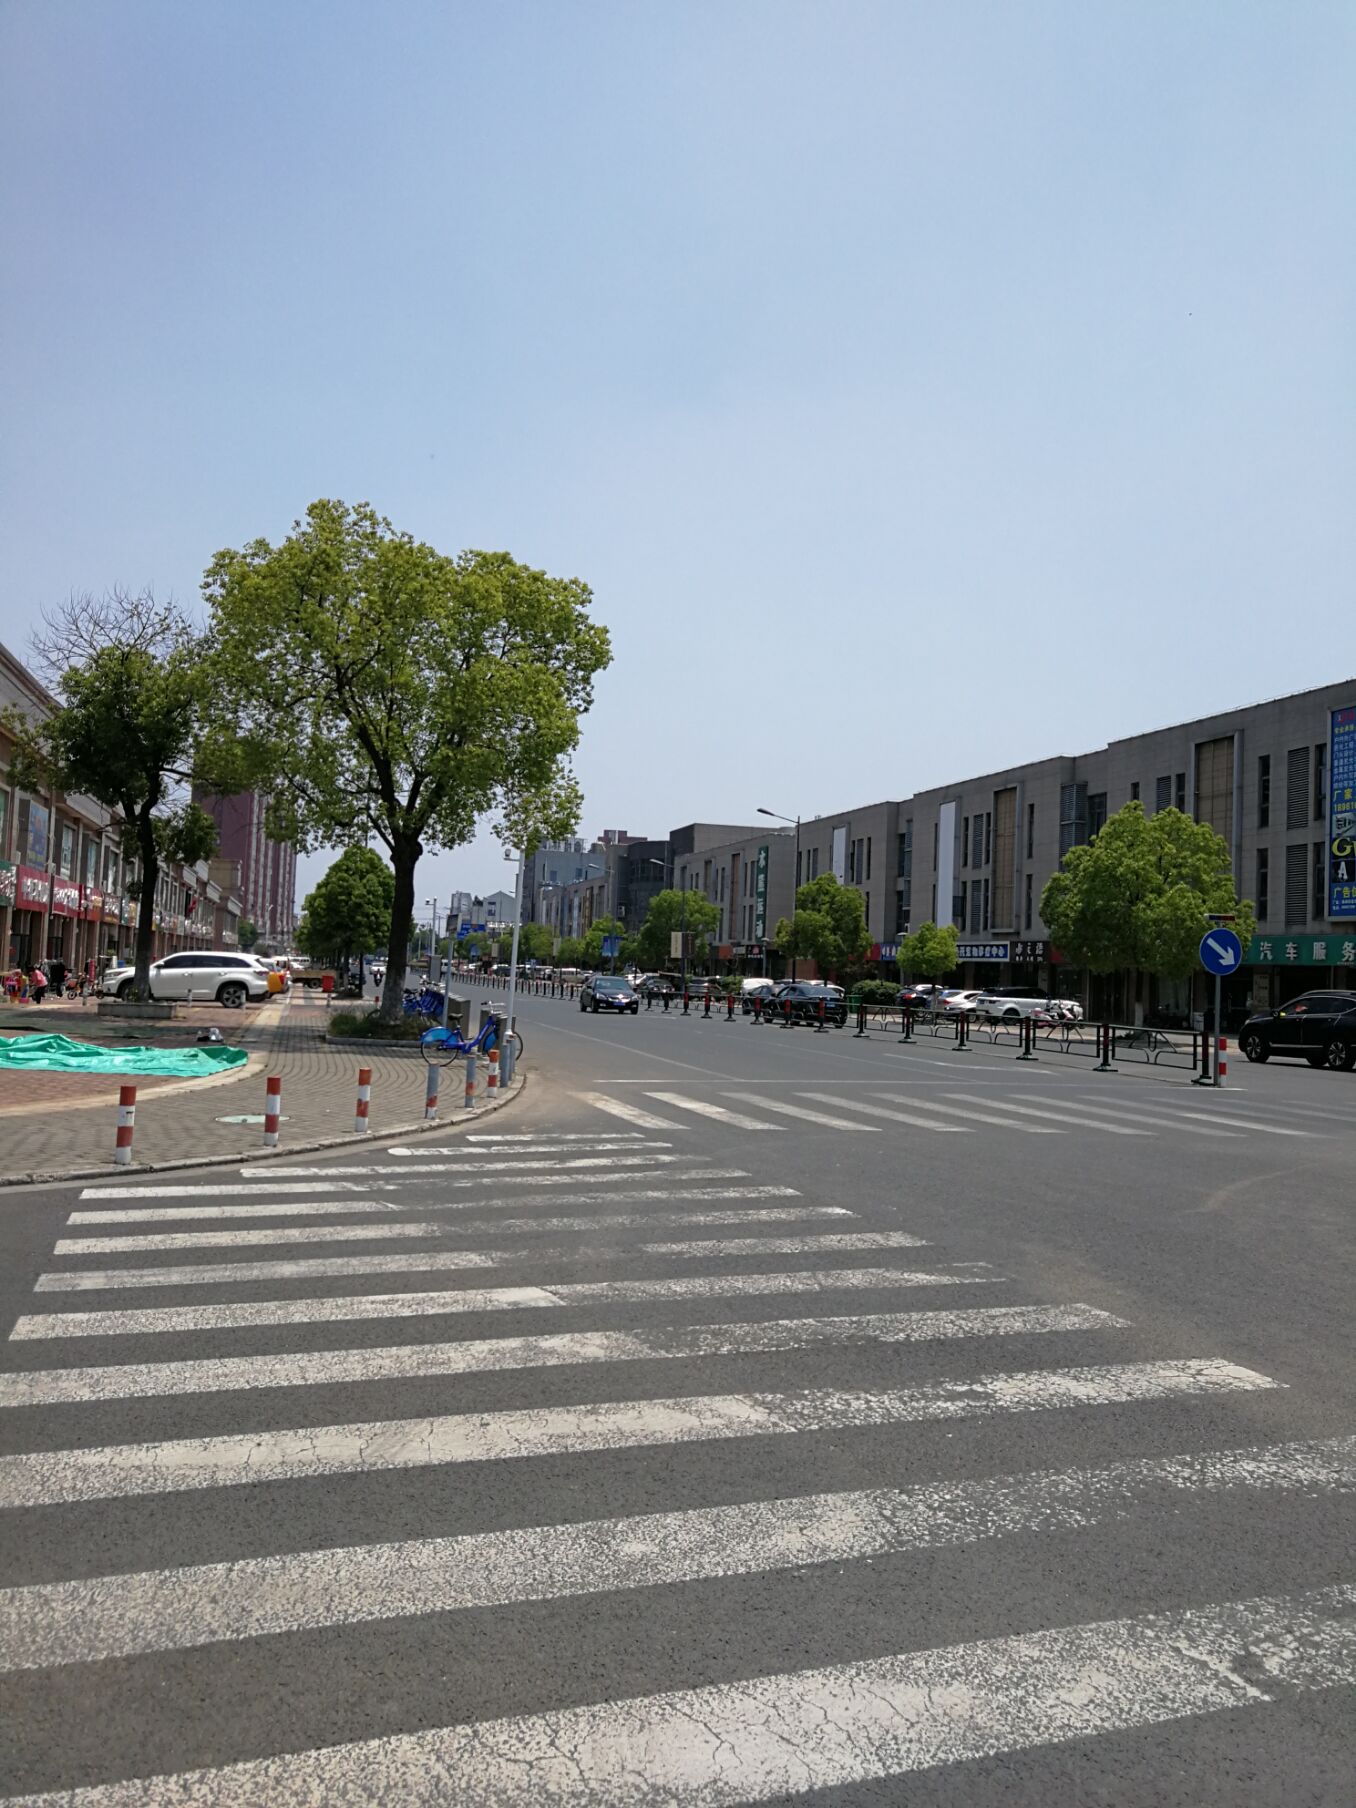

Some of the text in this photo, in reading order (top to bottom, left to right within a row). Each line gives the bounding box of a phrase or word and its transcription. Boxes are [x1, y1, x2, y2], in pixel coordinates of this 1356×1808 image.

[1337, 861, 1348, 880] A
[1260, 941, 1356, 961] 汽车服务
